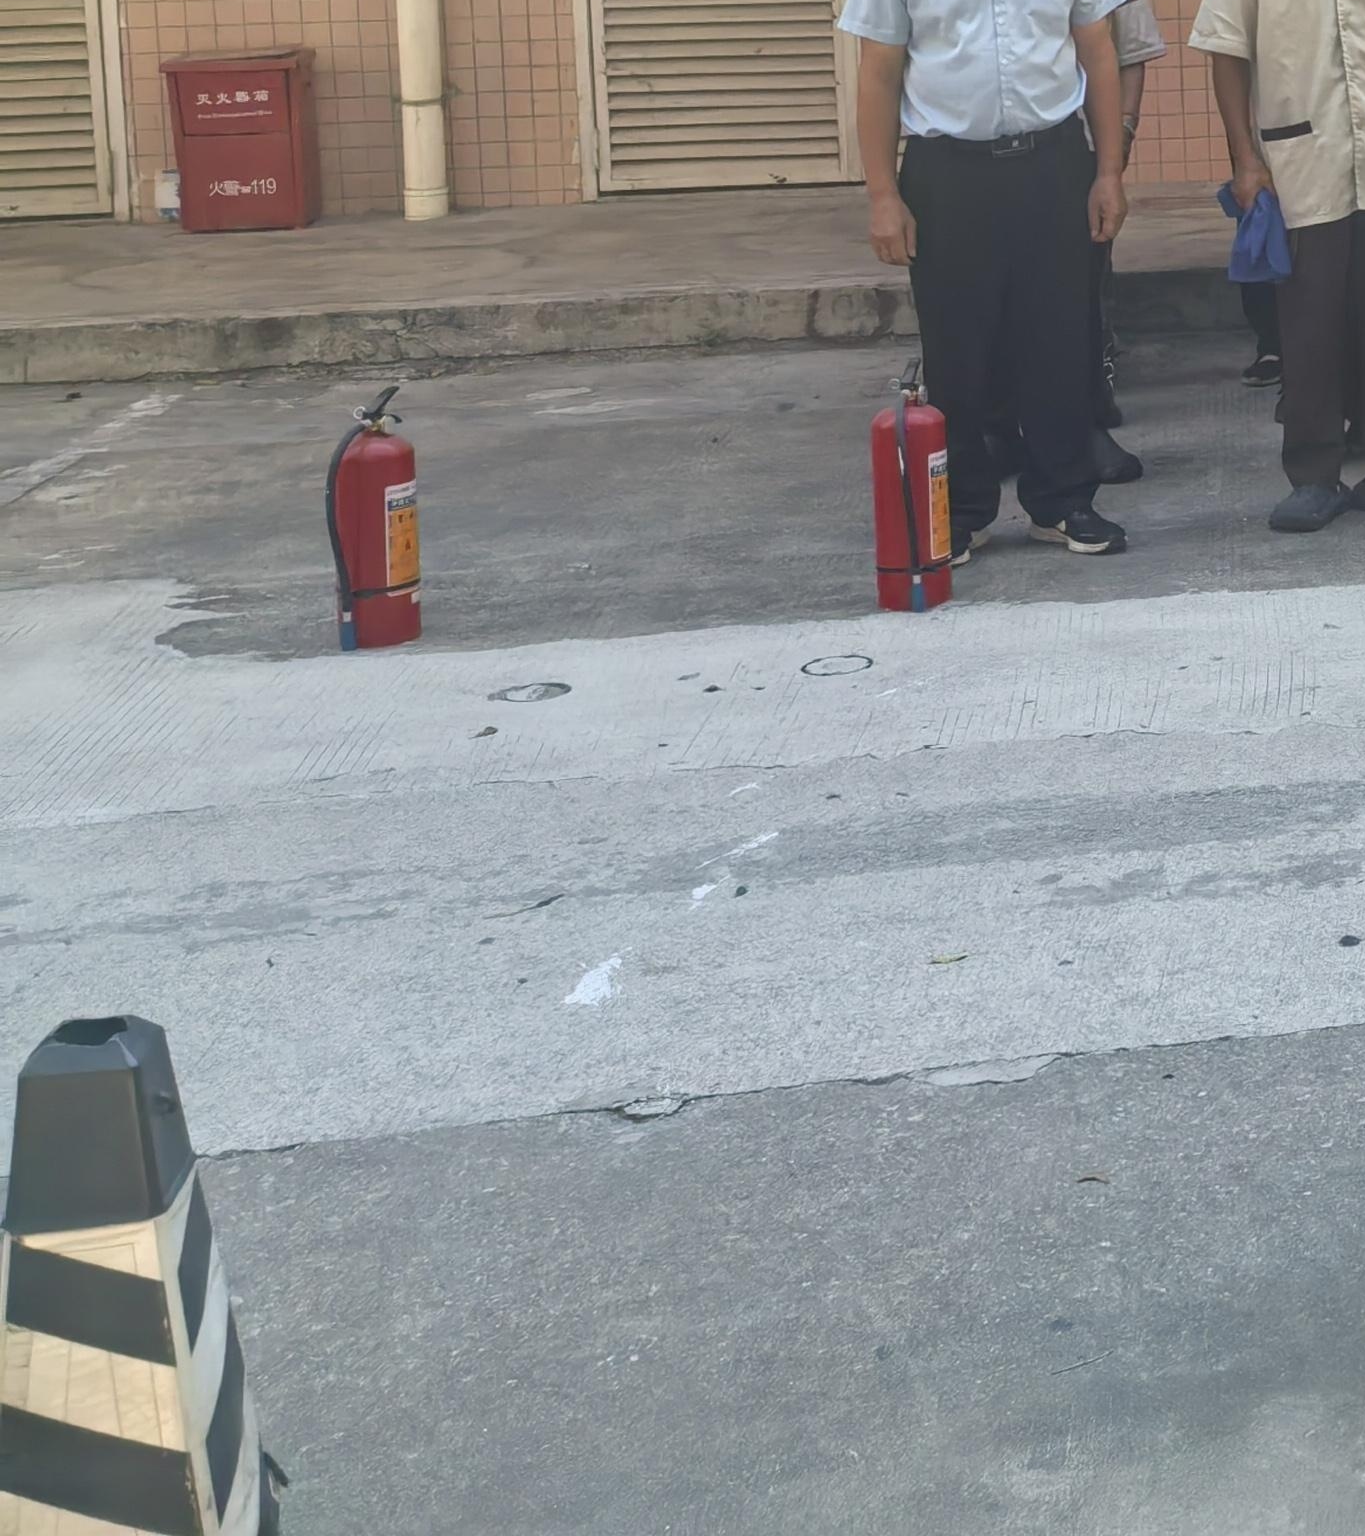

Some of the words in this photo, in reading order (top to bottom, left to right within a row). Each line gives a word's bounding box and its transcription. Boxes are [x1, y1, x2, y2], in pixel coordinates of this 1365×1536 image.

[196, 90, 269, 106] 灭火器箱
[251, 177, 277, 195] 119
